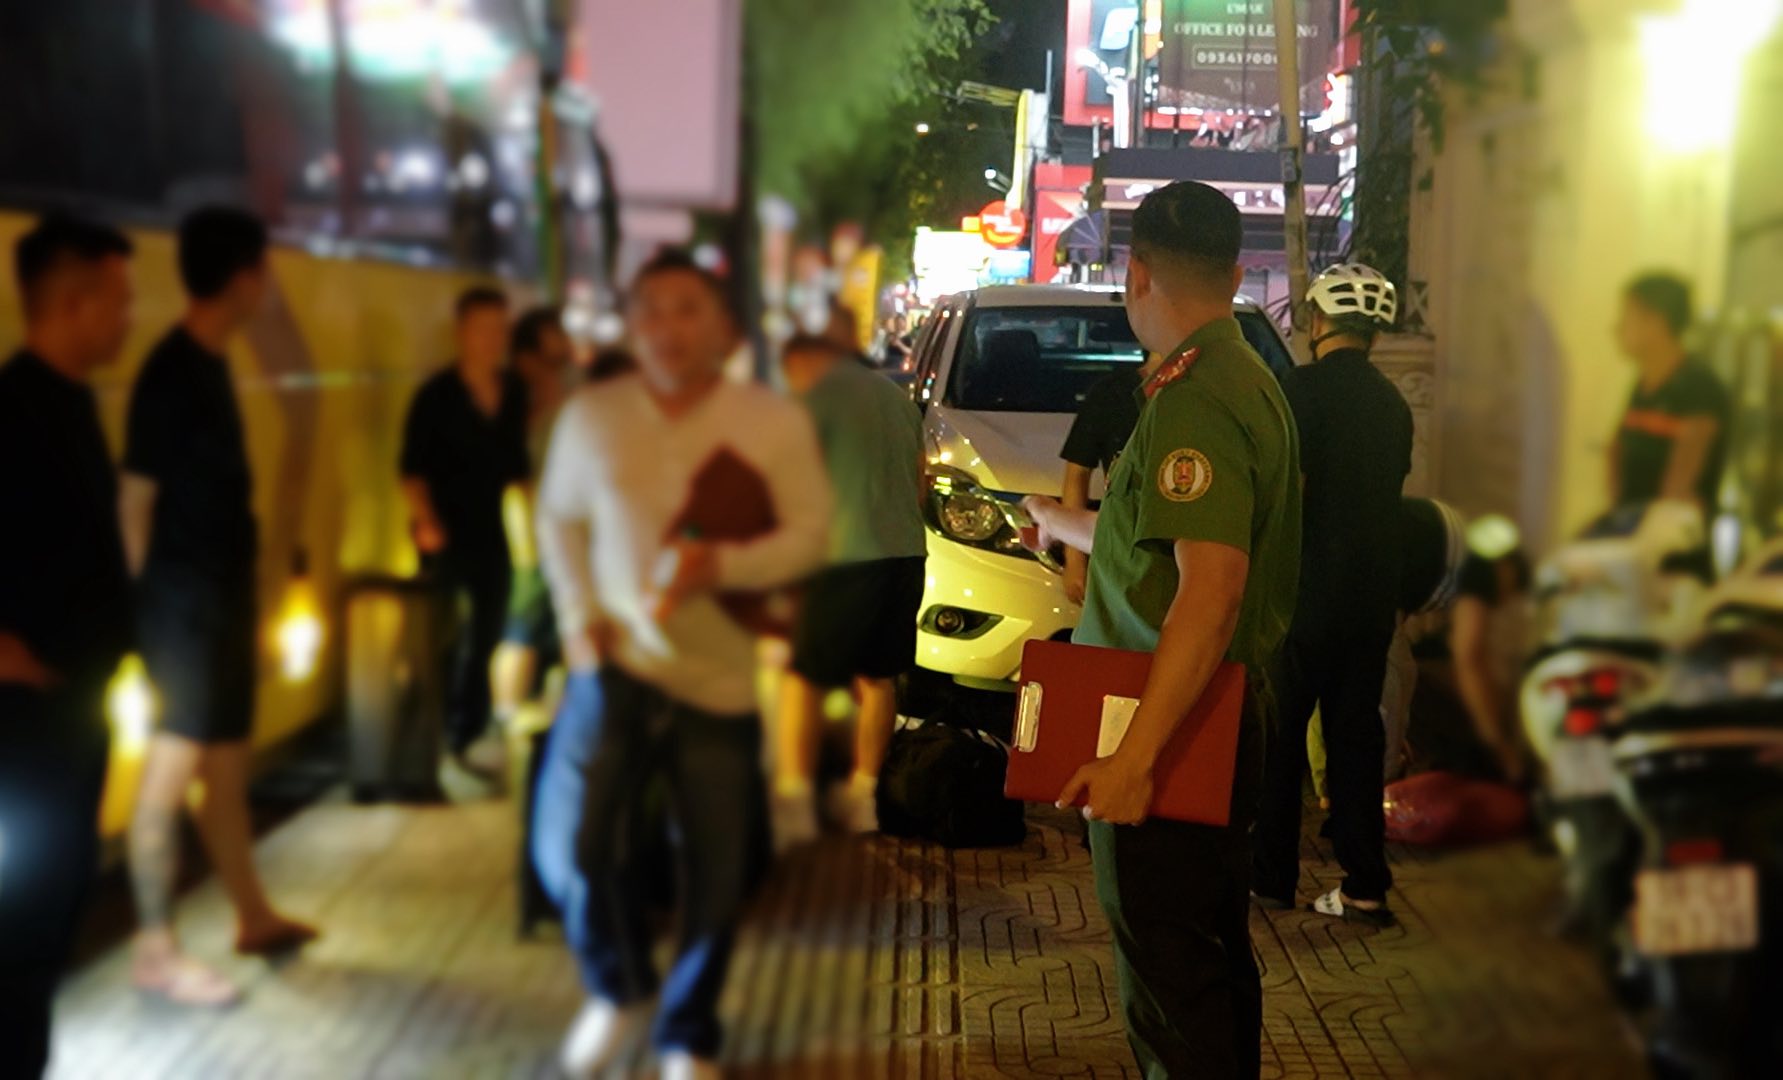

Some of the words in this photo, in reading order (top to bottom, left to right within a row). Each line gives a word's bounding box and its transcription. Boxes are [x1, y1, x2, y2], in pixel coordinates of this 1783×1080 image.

[1174, 23, 1223, 37] OFFICE
[1226, 23, 1255, 37] FOR
[1256, 24, 1318, 38] LENG
